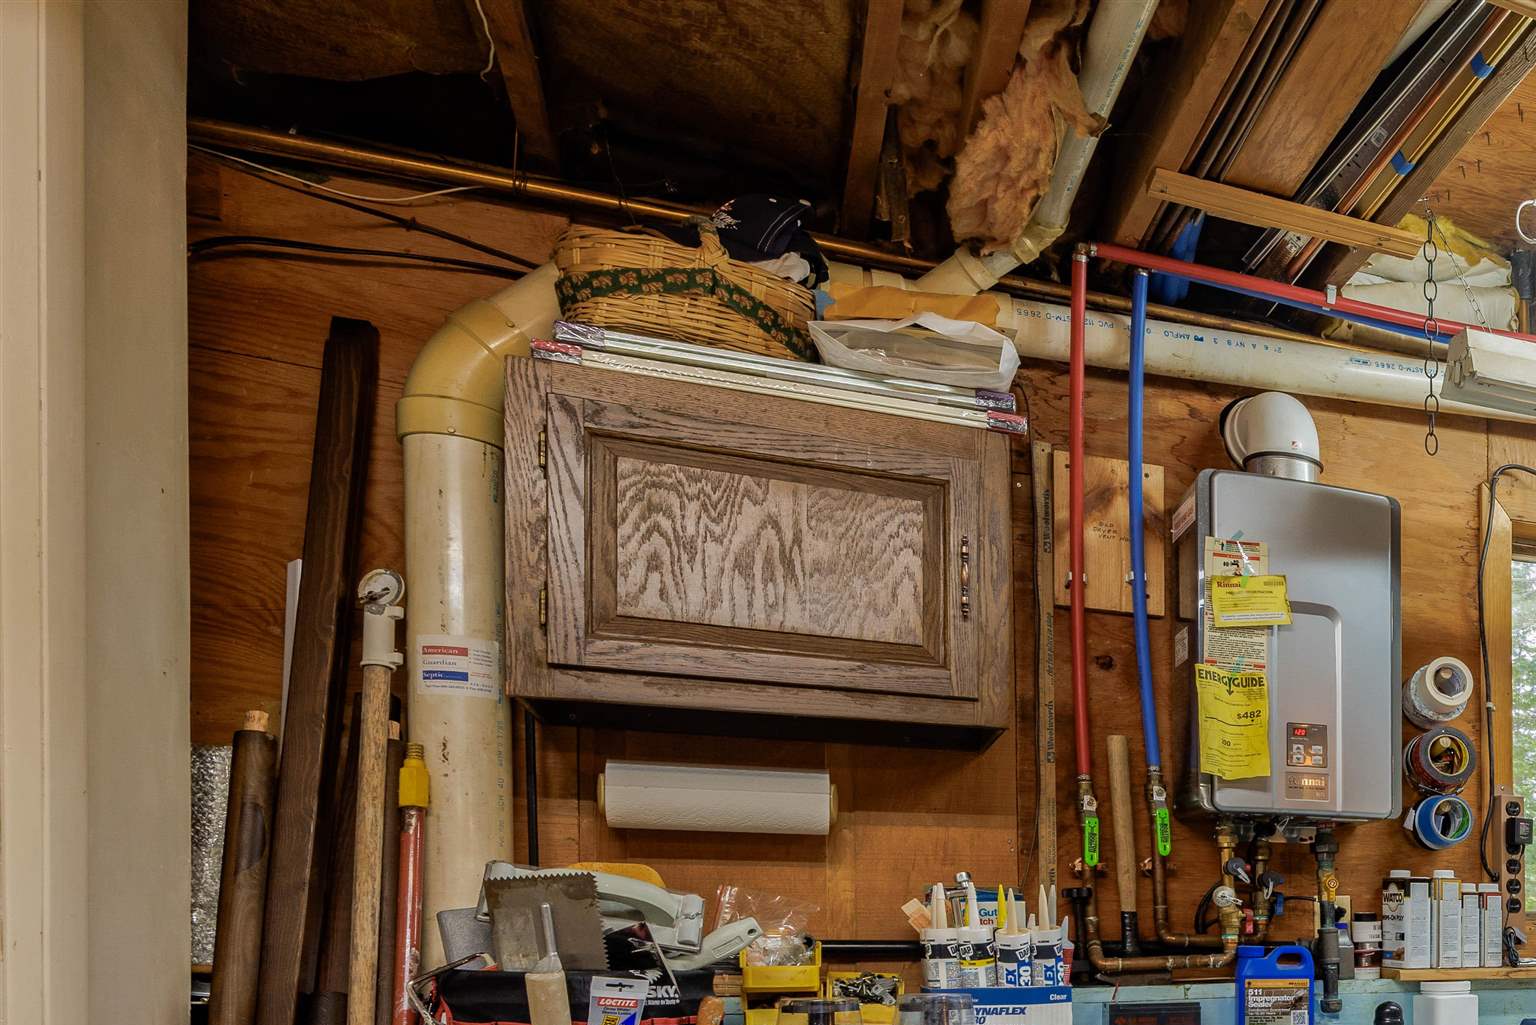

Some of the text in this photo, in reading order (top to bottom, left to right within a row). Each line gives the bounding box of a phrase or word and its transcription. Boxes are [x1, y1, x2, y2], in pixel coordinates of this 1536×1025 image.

[1237, 709, 1262, 720] $482
[599, 998, 637, 1007] LOCTITE
[975, 1007, 1026, 1015] YNAFLEX
